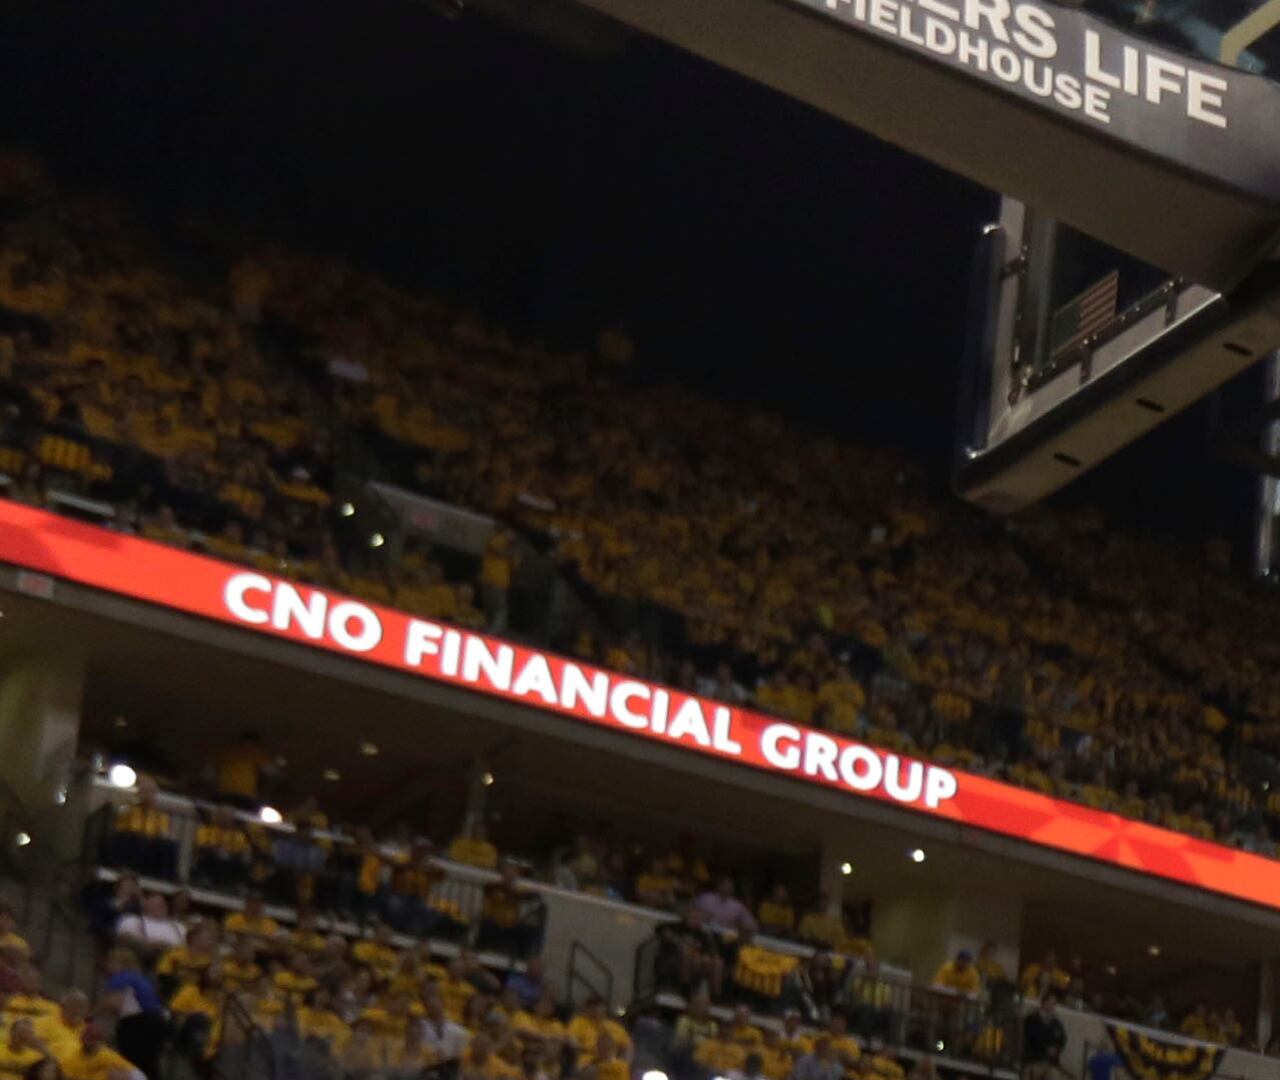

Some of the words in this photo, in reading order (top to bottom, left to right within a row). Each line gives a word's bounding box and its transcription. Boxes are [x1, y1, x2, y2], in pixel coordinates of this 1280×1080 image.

[826, 0, 1110, 123] IELDHOUSE
[1085, 31, 1228, 128] LIFE
[223, 573, 382, 652] CNO
[404, 620, 742, 755] FINANCIAL
[761, 722, 957, 809] GROUP
